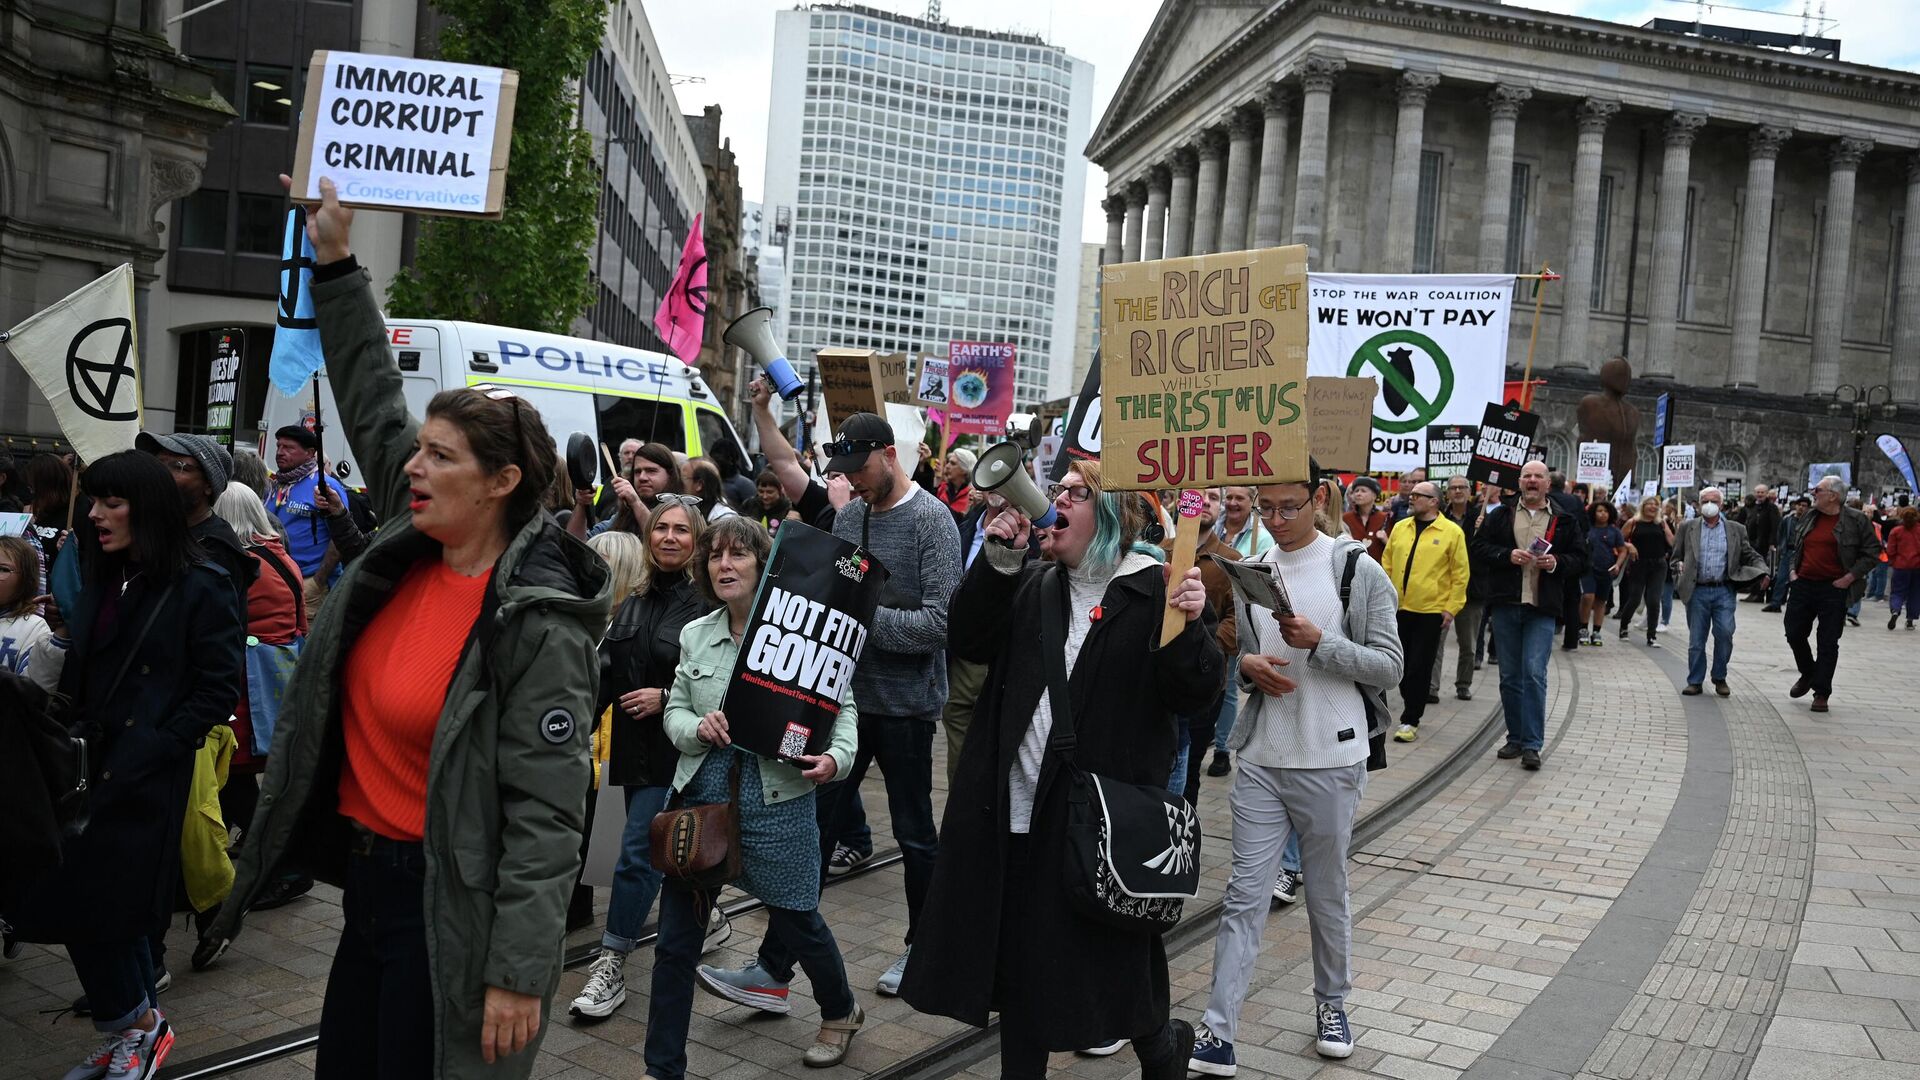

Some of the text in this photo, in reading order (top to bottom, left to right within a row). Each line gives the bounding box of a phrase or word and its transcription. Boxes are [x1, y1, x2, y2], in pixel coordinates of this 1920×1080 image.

[335, 64, 484, 101] IMMORAL
[331, 97, 484, 137] CORRUPT
[325, 141, 476, 178] CRIMINAL
[346, 181, 480, 205] Conservatives
[1114, 266, 1301, 322] THE RICH GET
[1313, 289, 1501, 300] STOP THE WAR COALITION
[1318, 306, 1496, 328] WE WON'T PAY
[951, 344, 1012, 357] EARTH'S
[1130, 319, 1275, 376] RICHER
[498, 339, 673, 386] POLICE
[881, 361, 906, 377] DUMP
[951, 355, 1005, 367] ON FIRE
[1160, 373, 1222, 392] WHILST
[1116, 393, 1162, 420] THE
[1164, 388, 1233, 433] REST
[1256, 381, 1301, 426] US
[1429, 438, 1474, 452] WAGES UP
[1480, 425, 1530, 449] NOT FIT TO
[1137, 432, 1274, 485] SUFFER
[1429, 454, 1449, 465] BILLS
[1476, 440, 1527, 466] GOVERN
[1582, 452, 1606, 460] TORIES
[1581, 459, 1605, 467] OUT!
[1667, 462, 1692, 470] OUT!
[1183, 491, 1201, 502] Stop
[288, 500, 310, 511] Unite
[1180, 507, 1197, 515] cuts
[761, 586, 826, 637] NOT
[819, 607, 858, 651] FIT
[549, 721, 569, 731] DLX
[789, 723, 809, 736] DONATE
